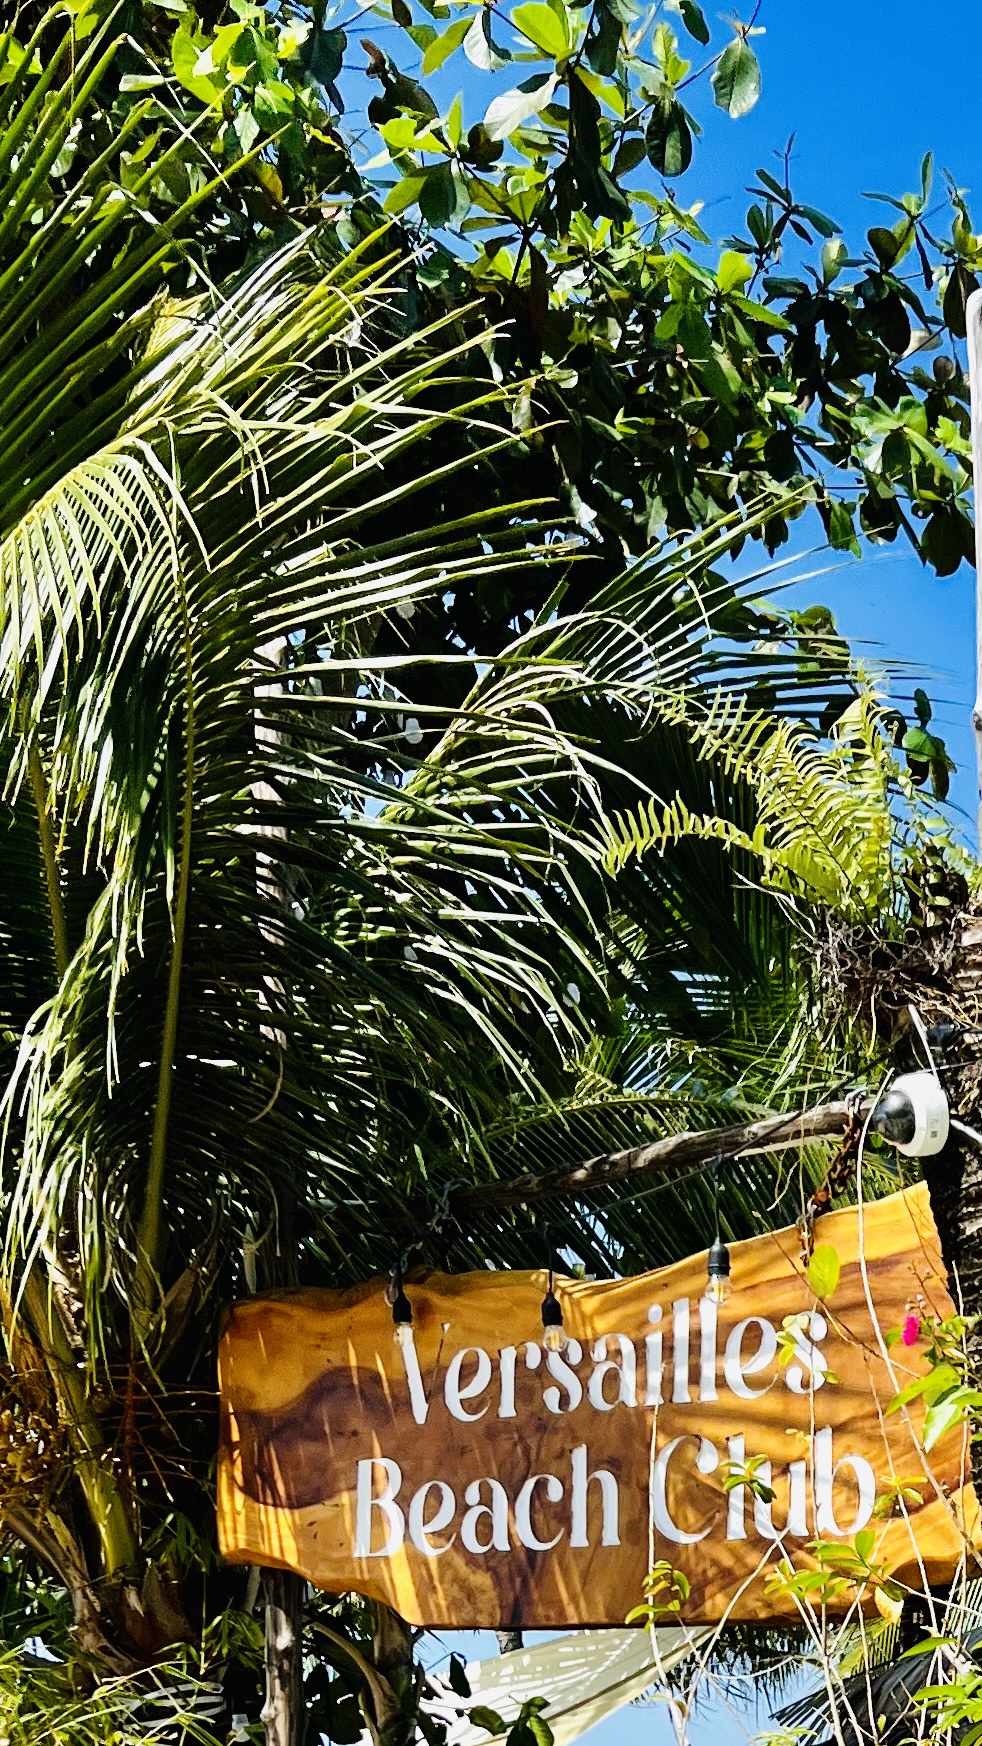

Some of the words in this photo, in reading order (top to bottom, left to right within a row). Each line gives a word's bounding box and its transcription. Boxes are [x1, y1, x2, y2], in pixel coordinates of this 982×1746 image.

[399, 1296, 829, 1425] Versailles
[353, 1443, 622, 1559] Beach
[653, 1425, 877, 1545] Club
